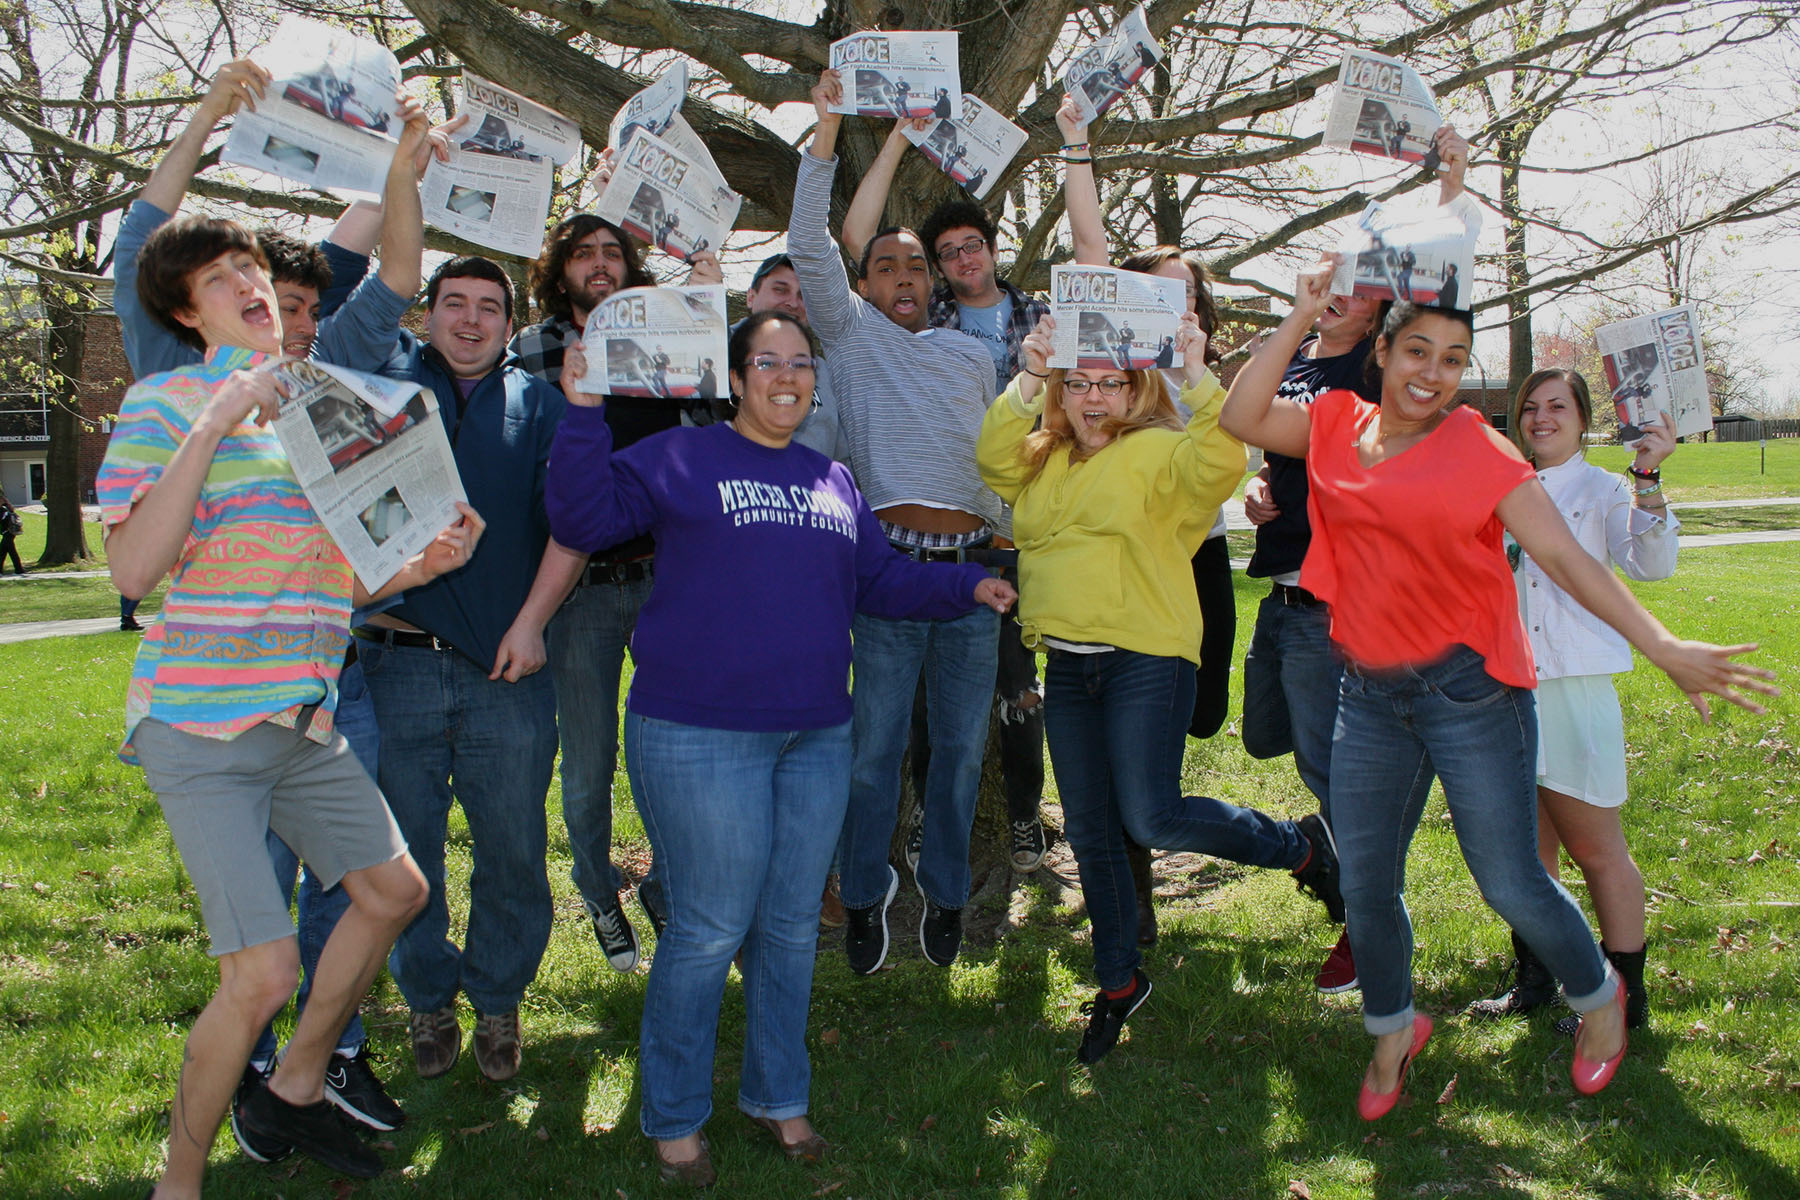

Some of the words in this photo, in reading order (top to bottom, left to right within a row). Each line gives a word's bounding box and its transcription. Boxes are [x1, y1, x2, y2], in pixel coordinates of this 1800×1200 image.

[835, 38, 889, 66] VOICE
[1064, 49, 1101, 90] VOICE
[1344, 56, 1402, 96] VOICE
[466, 78, 519, 117] VOICE
[627, 136, 689, 190] VOICE
[1058, 273, 1117, 303] VOICE
[593, 297, 646, 330] OICE
[1092, 305, 1116, 313] Academy
[1659, 311, 1698, 372] VOICE
[717, 479, 792, 514] MERCER
[734, 508, 804, 527] COMMUNITY
